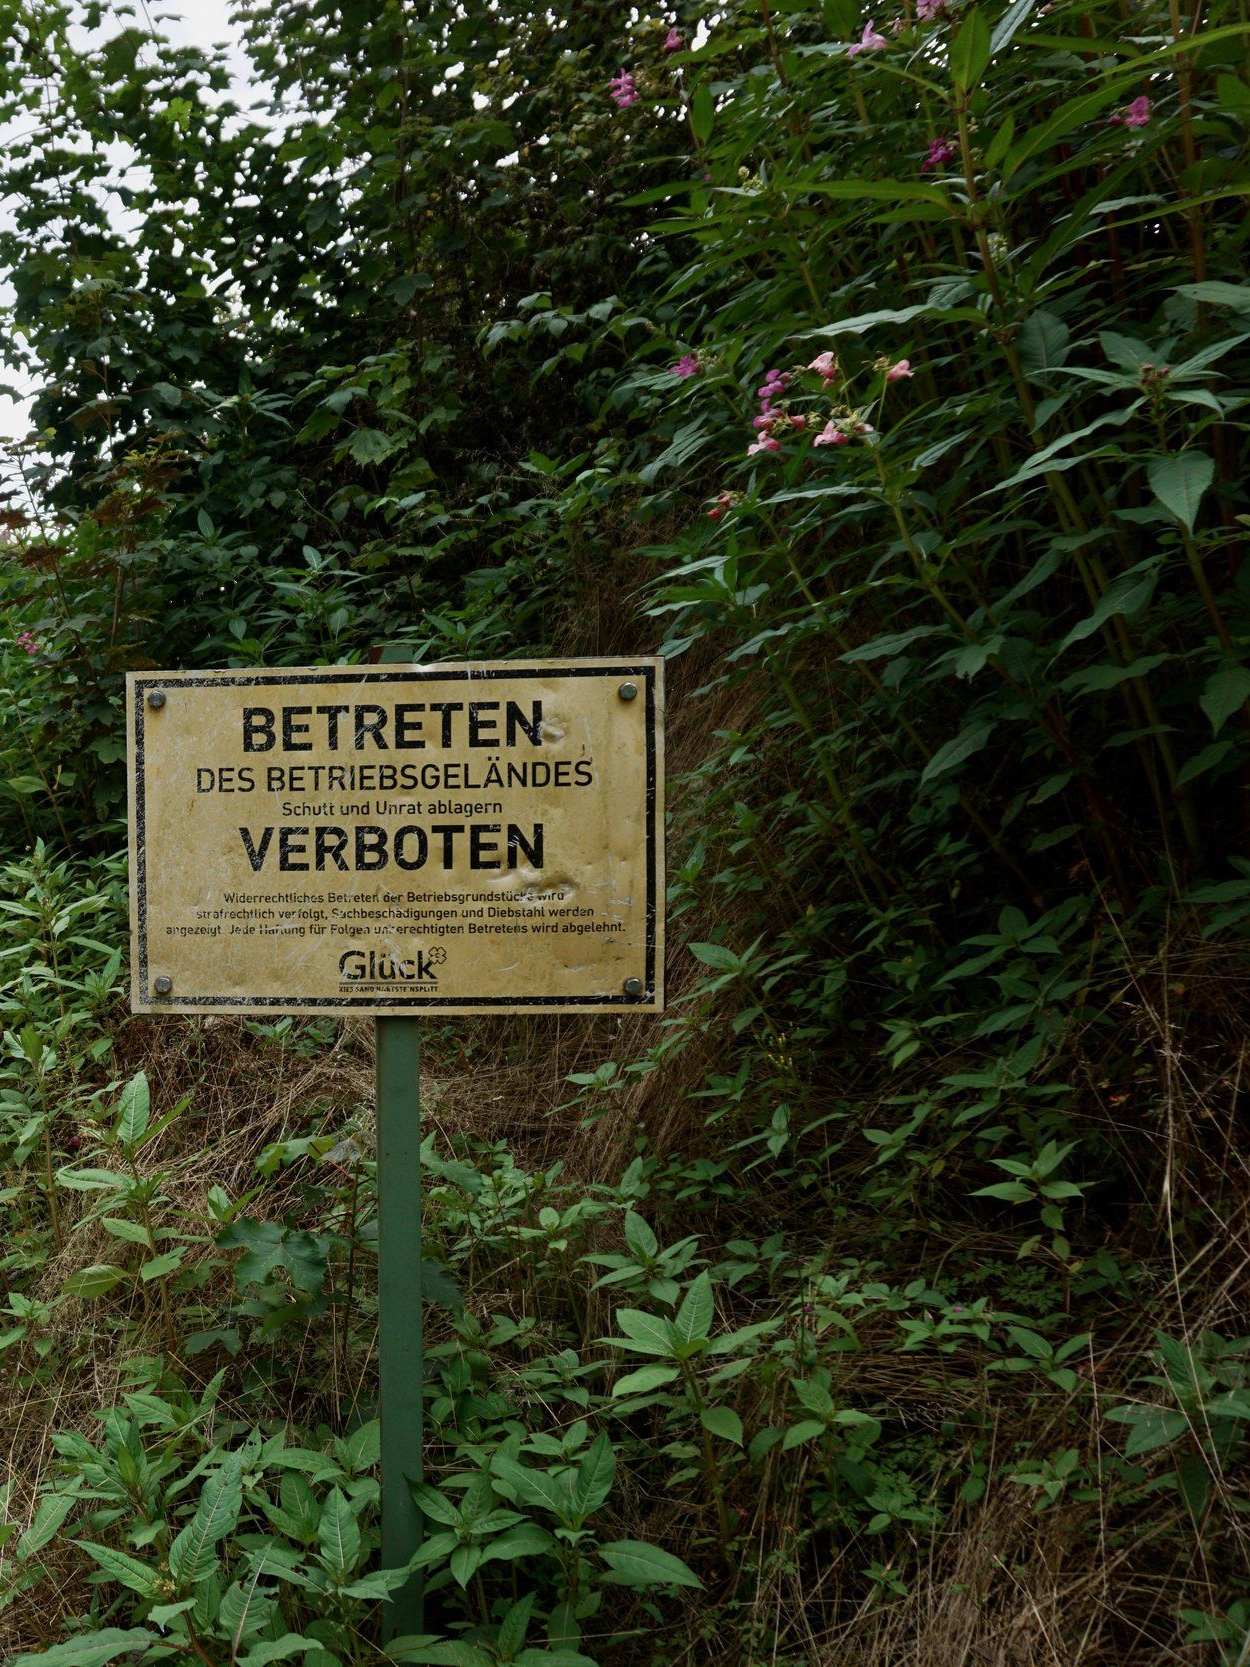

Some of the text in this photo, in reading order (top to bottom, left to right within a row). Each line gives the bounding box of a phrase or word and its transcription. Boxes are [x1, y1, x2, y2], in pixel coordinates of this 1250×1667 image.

[243, 700, 543, 752] BETRETEN
[196, 757, 594, 793] DES BETRIEBSGELÄNDES
[282, 799, 503, 817] Schutt und Unrat ablagern
[239, 823, 545, 872] VERBOTEN
[223, 890, 565, 905] Widerrechtliches Betreten der Betriebsgrundstücke wird
[196, 906, 595, 921] strafrechtlich verfolgt, Sachbeschädigungen und Diebstahl werden
[229, 924, 256, 936] Jede
[259, 924, 306, 938] Haftung
[309, 924, 327, 935] für
[330, 924, 370, 937] Folgen
[374, 924, 465, 937] unerechtigten
[468, 923, 528, 934] Betretens
[532, 922, 558, 933] wird
[562, 922, 627, 936] abgelehnt.
[339, 950, 438, 980] Glück
